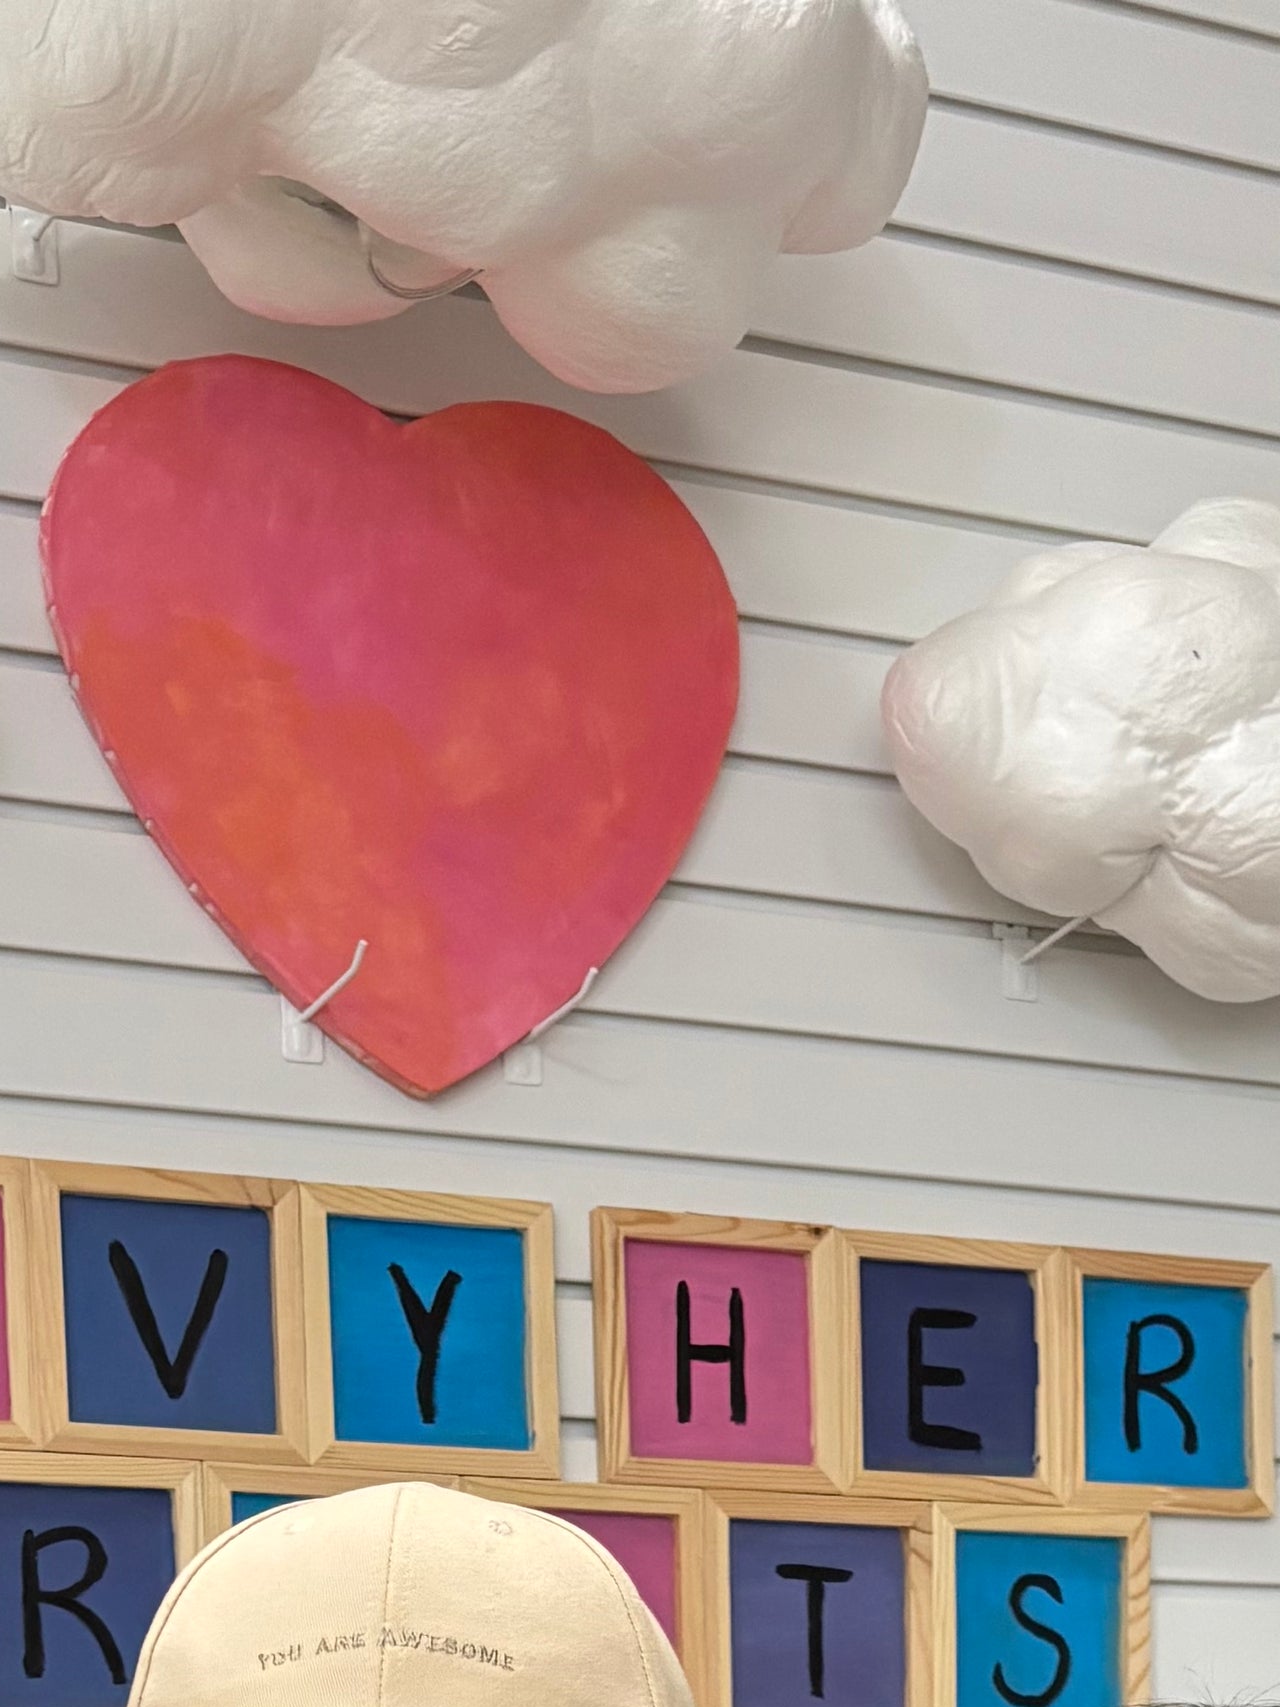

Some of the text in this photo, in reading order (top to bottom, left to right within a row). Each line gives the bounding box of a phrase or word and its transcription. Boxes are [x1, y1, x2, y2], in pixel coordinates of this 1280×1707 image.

[675, 1279, 1200, 1457] HER
[257, 1626, 518, 1673] YOU ARE AWESOME
